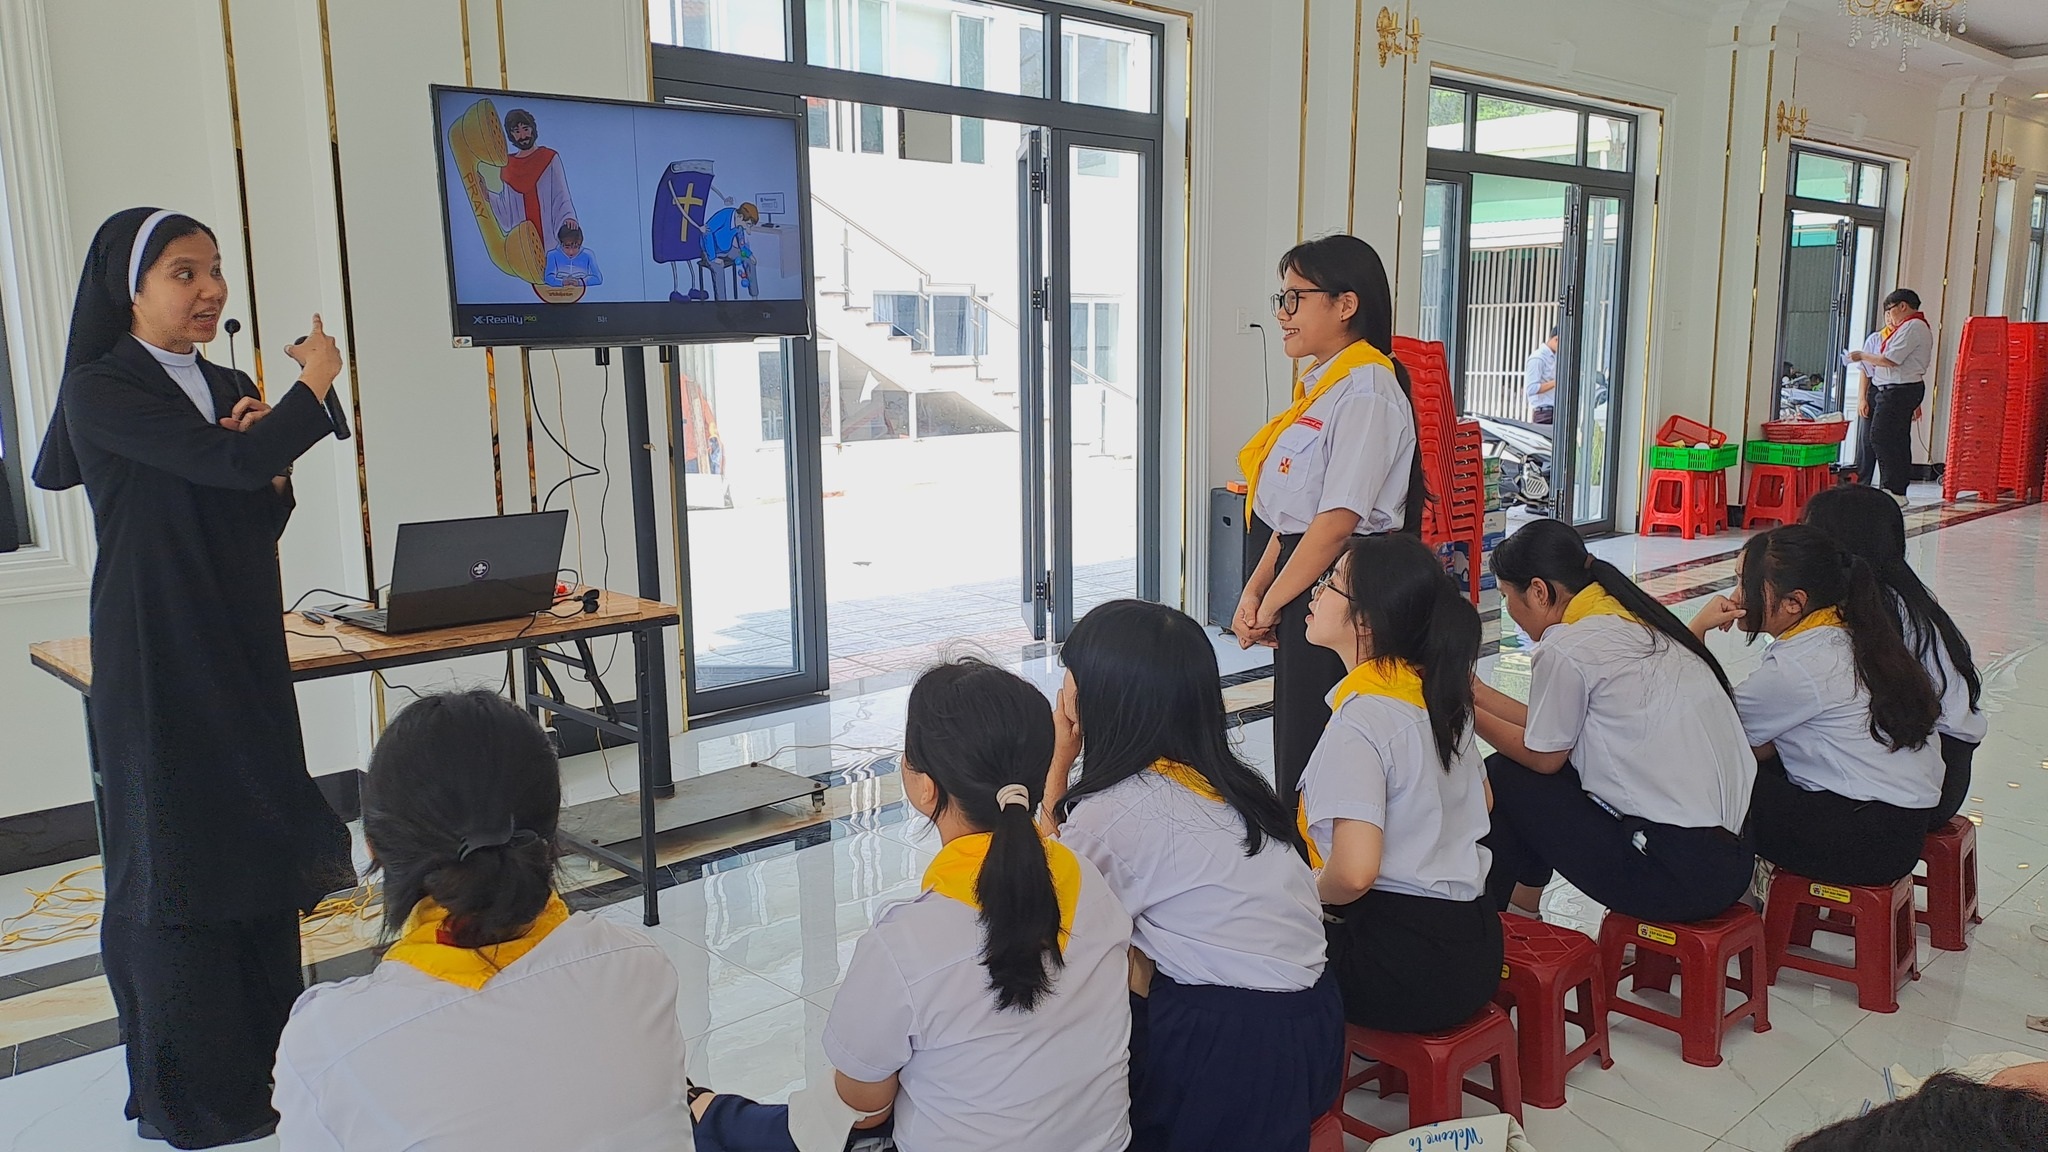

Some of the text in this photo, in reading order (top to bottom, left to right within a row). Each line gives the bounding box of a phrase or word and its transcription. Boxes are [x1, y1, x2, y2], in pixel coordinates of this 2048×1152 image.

[463, 172, 488, 219] PRAY
[1409, 1127, 1483, 1152] Welcome to
